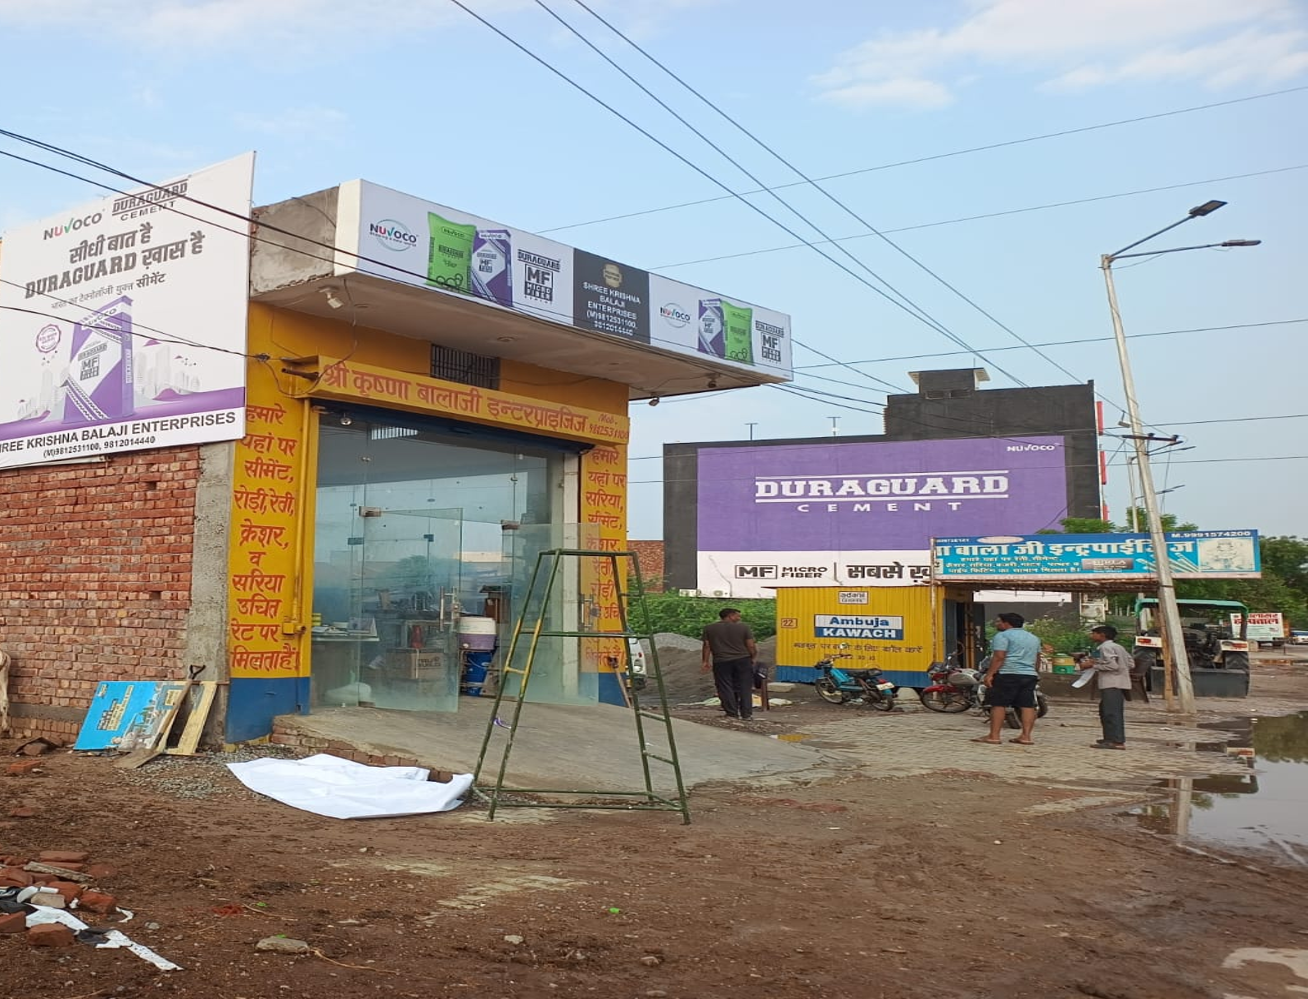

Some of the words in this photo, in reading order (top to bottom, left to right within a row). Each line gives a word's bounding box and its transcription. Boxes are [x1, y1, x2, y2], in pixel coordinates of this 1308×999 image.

[111, 178, 189, 216] DURAGUARD
[120, 200, 177, 222] CEMENT
[43, 212, 103, 241] NUVOCO
[369, 221, 418, 245] NUVOCO
[68, 239, 104, 265] सीधी
[107, 232, 137, 254] बात
[140, 221, 154, 246] है
[24, 252, 138, 300] DURAGUARD
[190, 230, 206, 256] है
[516, 249, 562, 272] DURAGUARD
[136, 270, 167, 292] सीमेंट
[527, 266, 551, 286] MF
[587, 300, 638, 320] ENTERPRISES
[599, 295, 627, 309] BALAJI
[659, 305, 691, 323] NUVOCO
[323, 362, 350, 391] श्री
[415, 381, 484, 415] बालाजी
[26, 430, 80, 450] KRISHNA
[81, 424, 129, 443] BALAJI
[131, 411, 236, 437] ENTERPRISES
[103, 434, 157, 453] 9812014440
[1006, 443, 1056, 454] NUVOCO
[244, 457, 295, 484] सीमेंट,
[755, 474, 1010, 499] DURAGUARD
[796, 501, 964, 514] CEMENT
[239, 517, 290, 551] क्रेशर,
[738, 566, 776, 579] MF
[781, 565, 829, 574] MICRO
[781, 572, 825, 580] FIBER
[846, 560, 903, 580] सबसे
[231, 568, 286, 594] सरिया
[235, 592, 284, 619] उचित
[822, 627, 897, 639] KAWACH
[829, 616, 890, 629] Ambuja
